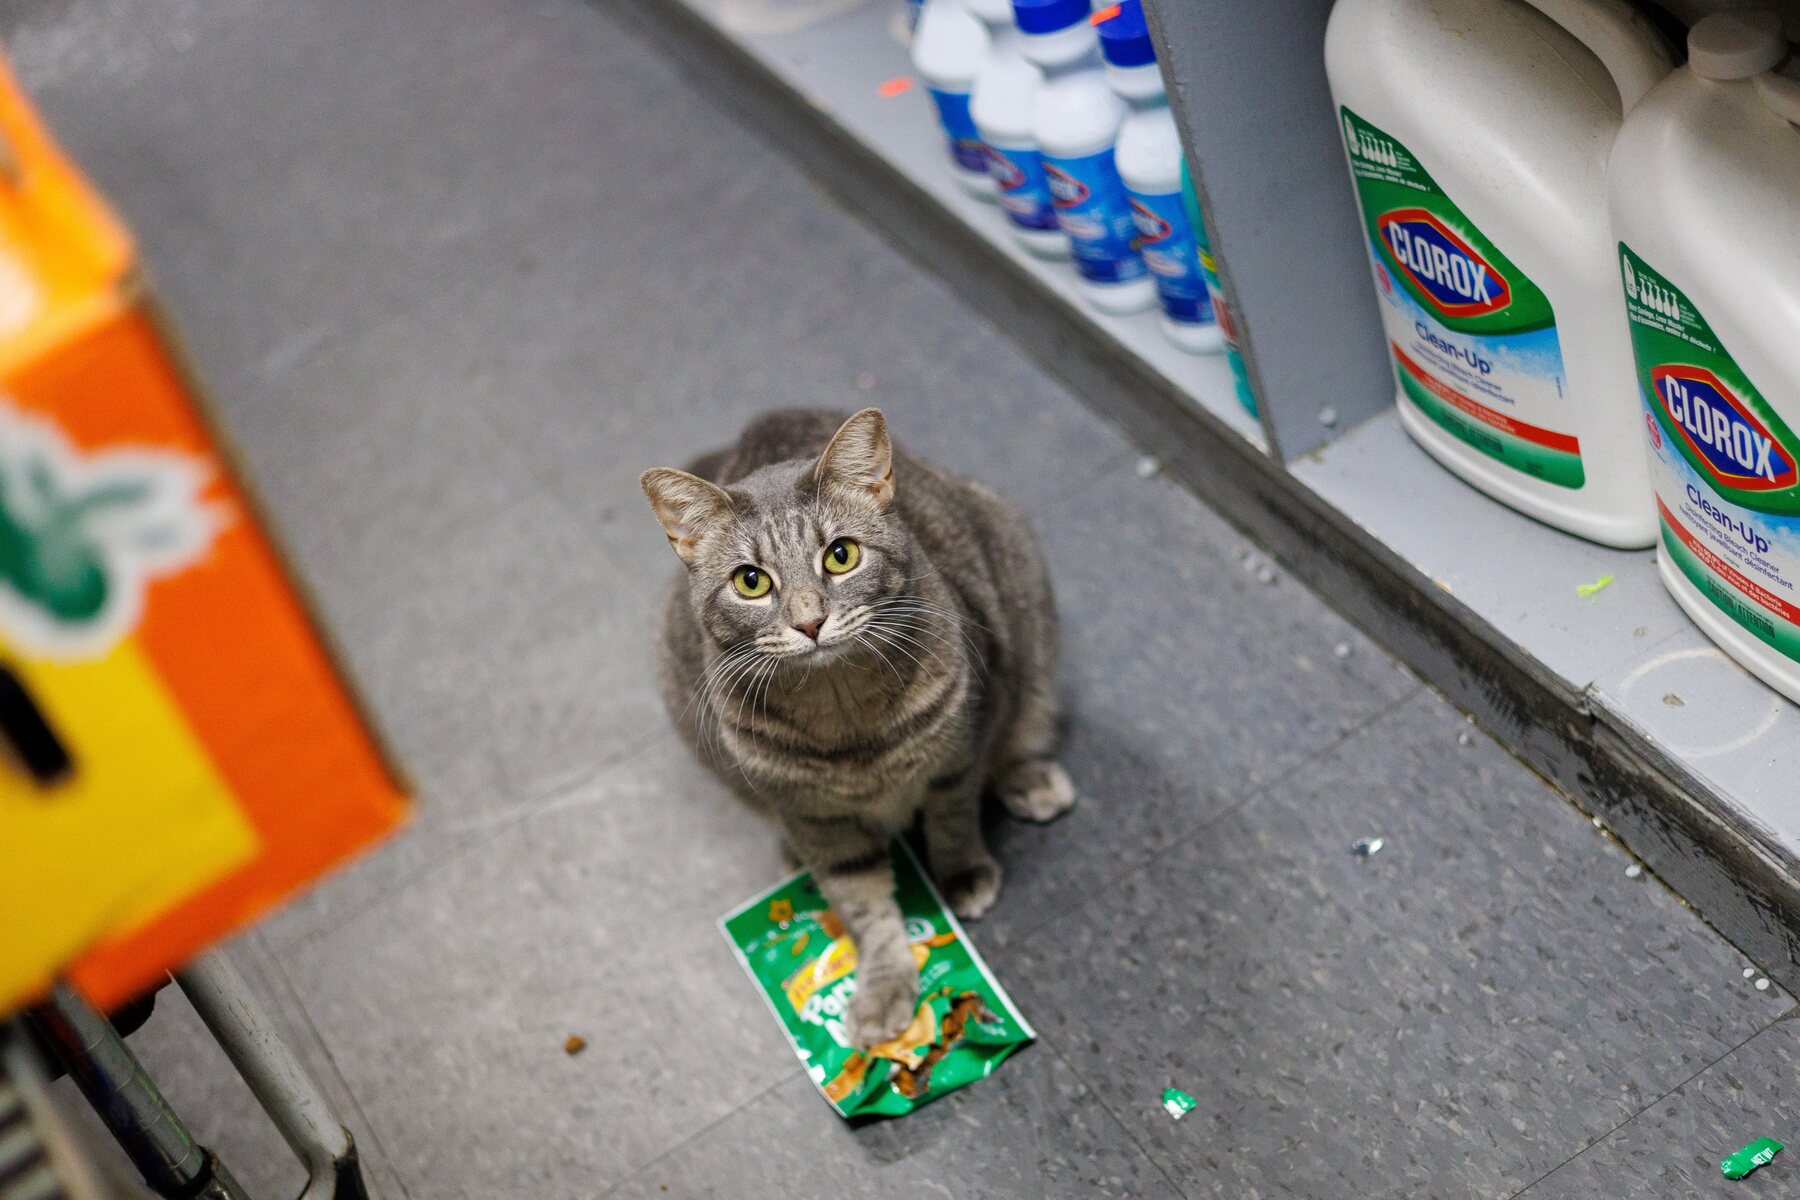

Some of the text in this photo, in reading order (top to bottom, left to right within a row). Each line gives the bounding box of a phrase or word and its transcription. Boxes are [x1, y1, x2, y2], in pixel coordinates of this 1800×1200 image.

[1388, 220, 1492, 307] CLOROX
[1415, 320, 1490, 375] Clean-Up
[1665, 374, 1776, 484] CLOROX
[1686, 483, 1769, 554] Clean-Up
[1723, 533, 1748, 556] Bleach
[1749, 551, 1780, 574] Cleaner
[1744, 557, 1794, 591] désinfectant
[1738, 603, 1775, 639] ATTENTION
